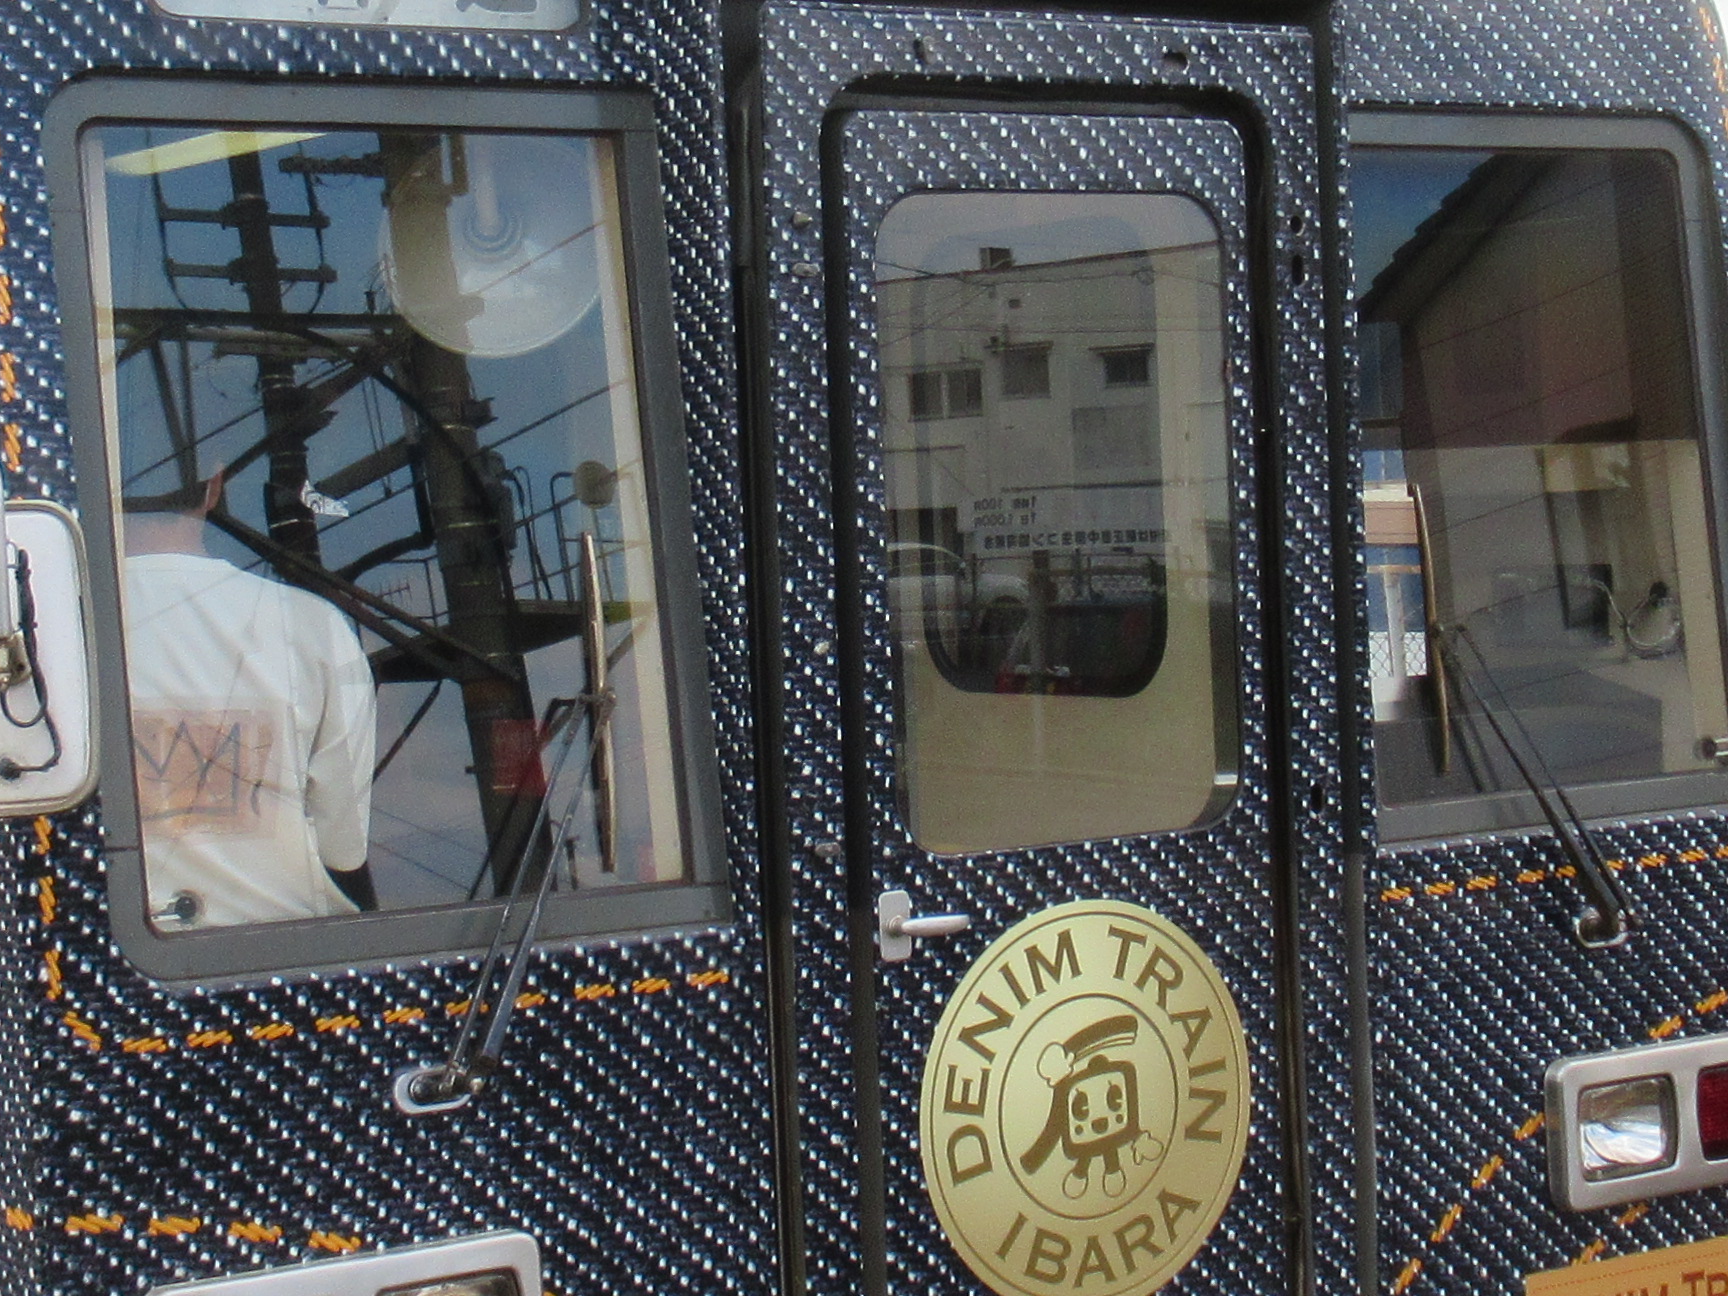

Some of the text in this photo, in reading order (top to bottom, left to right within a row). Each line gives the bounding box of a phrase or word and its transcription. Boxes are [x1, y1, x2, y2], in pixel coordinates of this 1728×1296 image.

[943, 923, 1229, 1187] DENIM TRAIN
[994, 1187, 1204, 1289] IBARA
